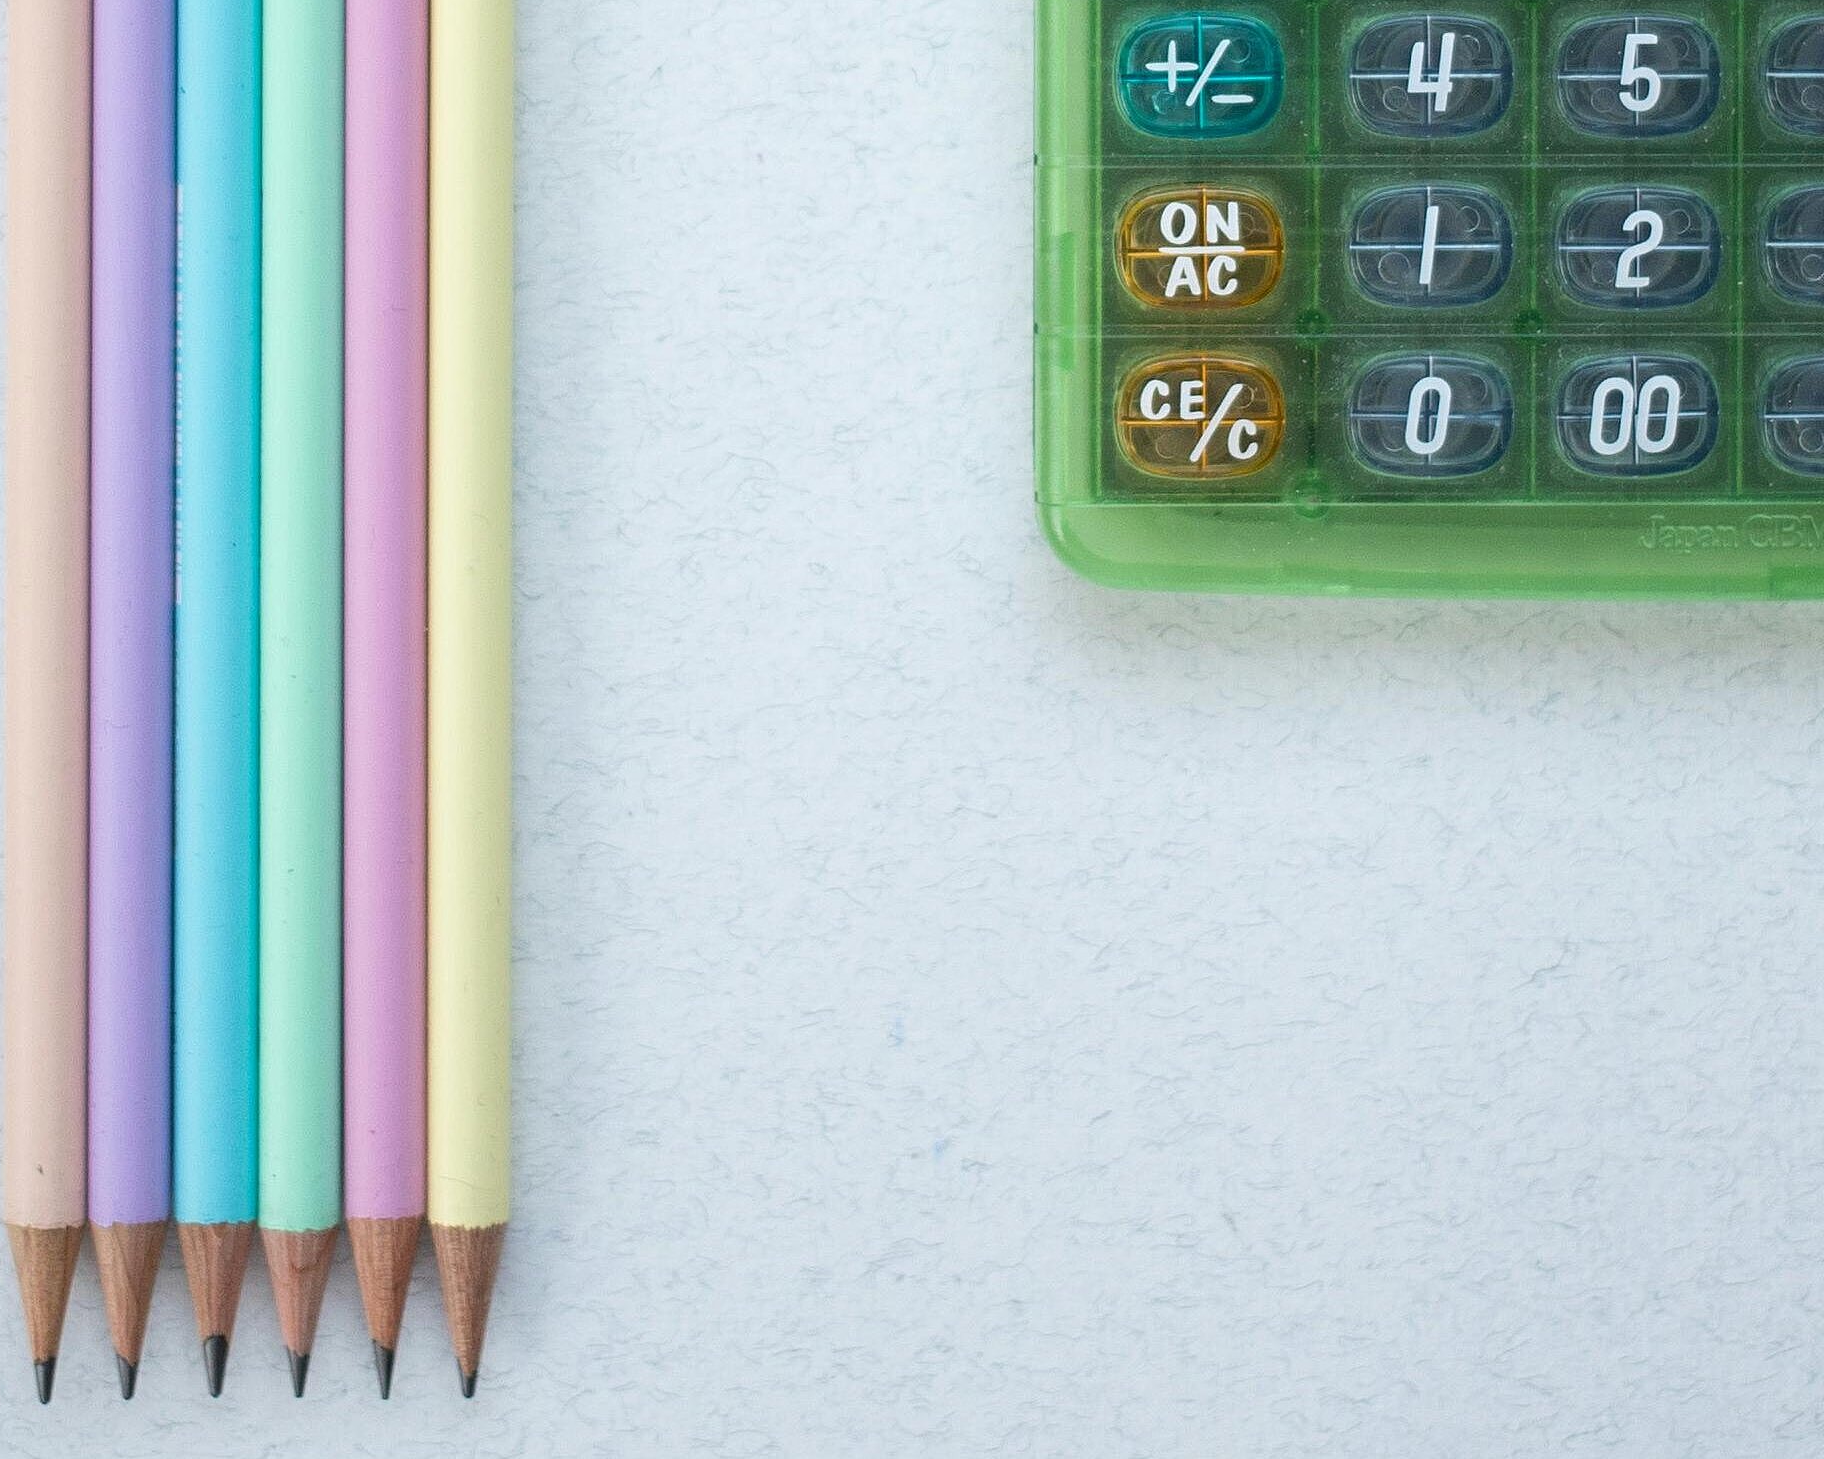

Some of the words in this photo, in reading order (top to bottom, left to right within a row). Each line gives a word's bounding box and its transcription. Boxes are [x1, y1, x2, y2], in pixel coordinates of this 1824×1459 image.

[1406, 31, 1455, 113] 4
[1618, 32, 1661, 113] 5
[1159, 200, 1241, 246] ON
[1417, 204, 1442, 286] 1
[1614, 209, 1660, 289] 2
[1163, 253, 1239, 299] AC
[1139, 377, 1259, 464] CE/C
[1404, 375, 1454, 456] 0
[1589, 376, 1688, 456] 00
[1641, 513, 1737, 554] Japan
